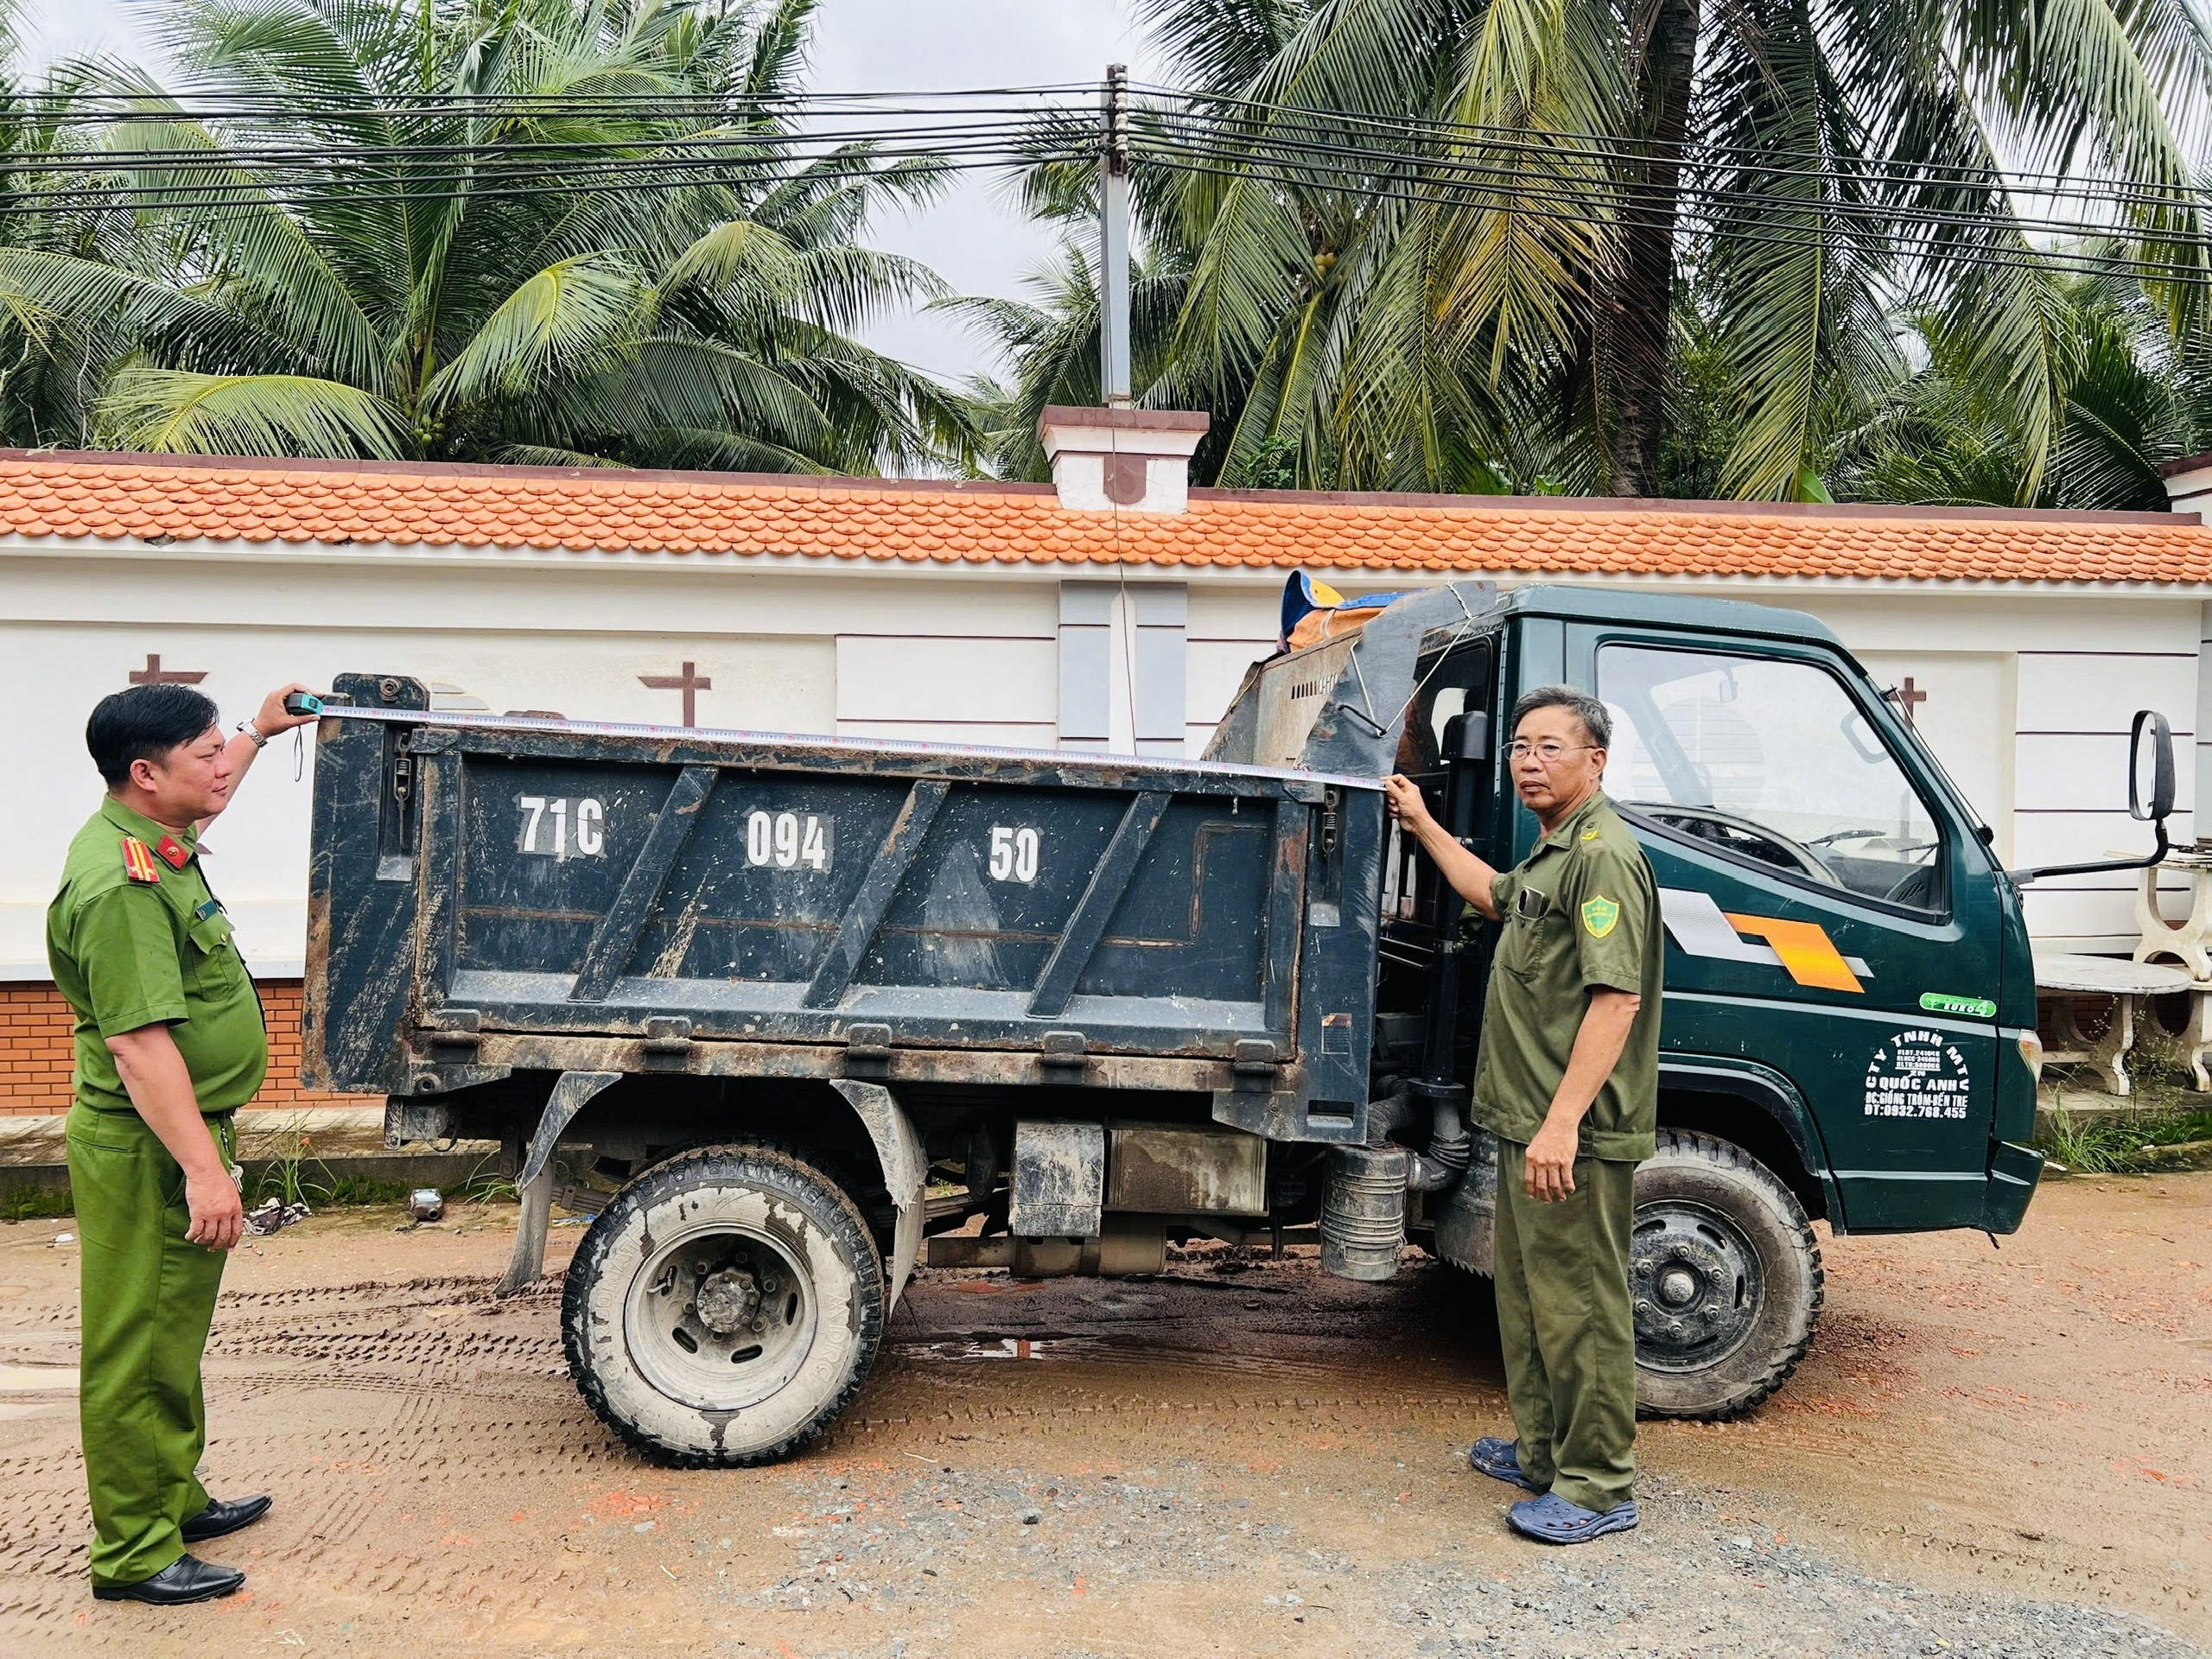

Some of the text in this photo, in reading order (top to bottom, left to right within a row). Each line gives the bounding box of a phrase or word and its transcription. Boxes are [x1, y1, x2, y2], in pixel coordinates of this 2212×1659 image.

[520, 797, 1038, 882] 71C 094 50
[1866, 1030, 1969, 1091] CTY TNHH MTV
[1925, 1078, 1958, 1092] ANH
[1952, 1095, 1969, 1108] TRE
[813, 1325, 848, 1382] DRC
